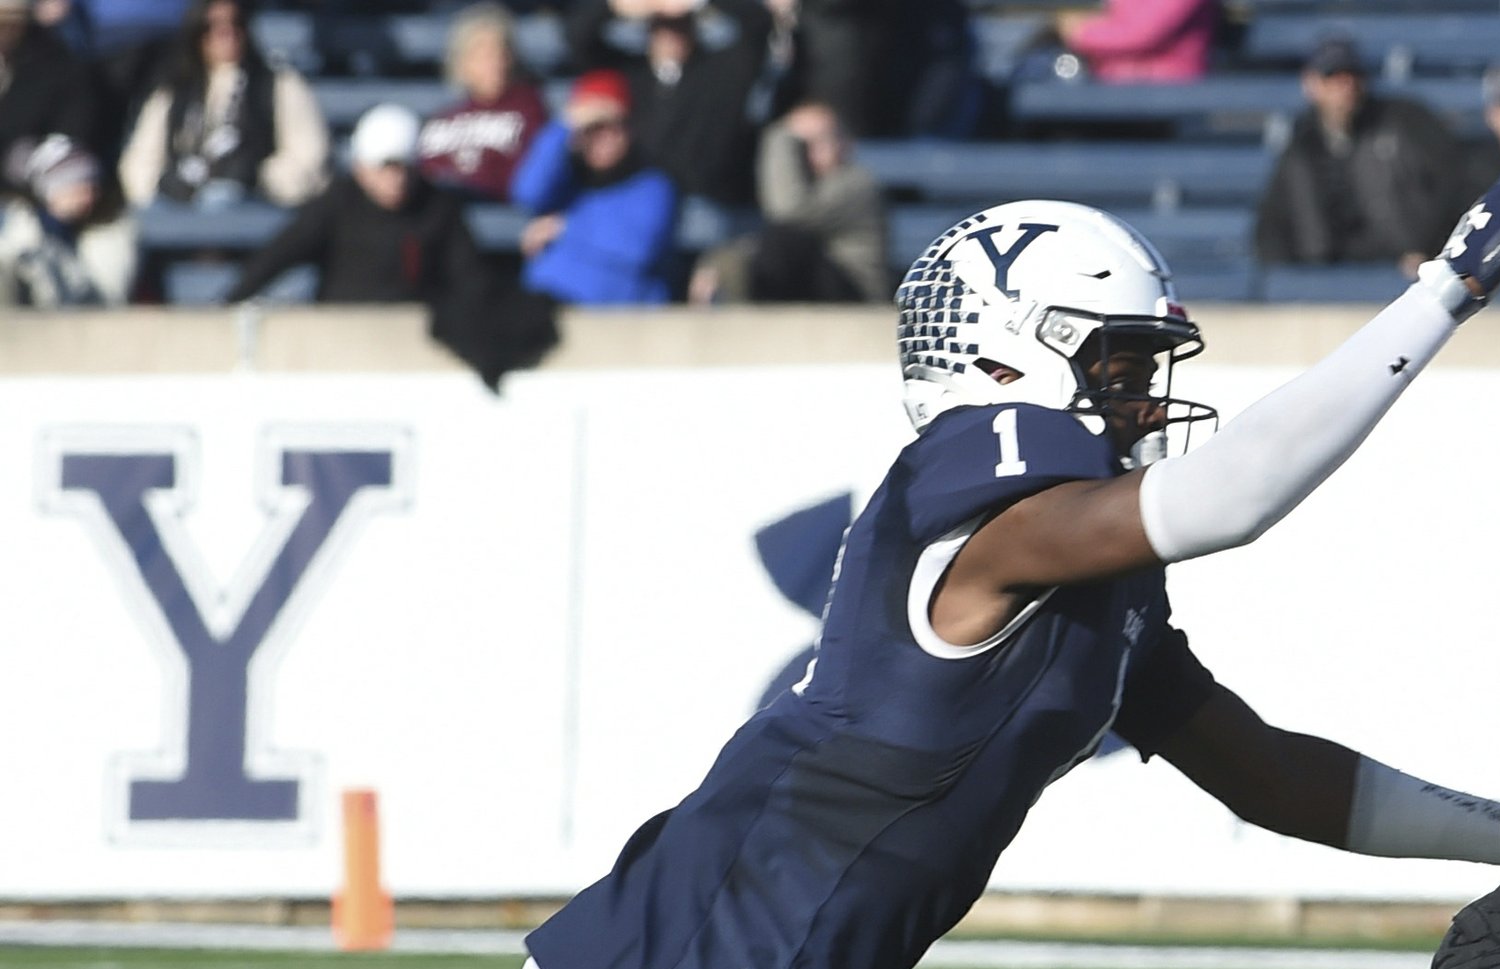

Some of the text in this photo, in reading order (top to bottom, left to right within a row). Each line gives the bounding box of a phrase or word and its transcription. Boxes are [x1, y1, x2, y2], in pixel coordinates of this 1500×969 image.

[966, 222, 1060, 302] Y
[992, 407, 1027, 478] 1
[55, 444, 398, 826] Y
